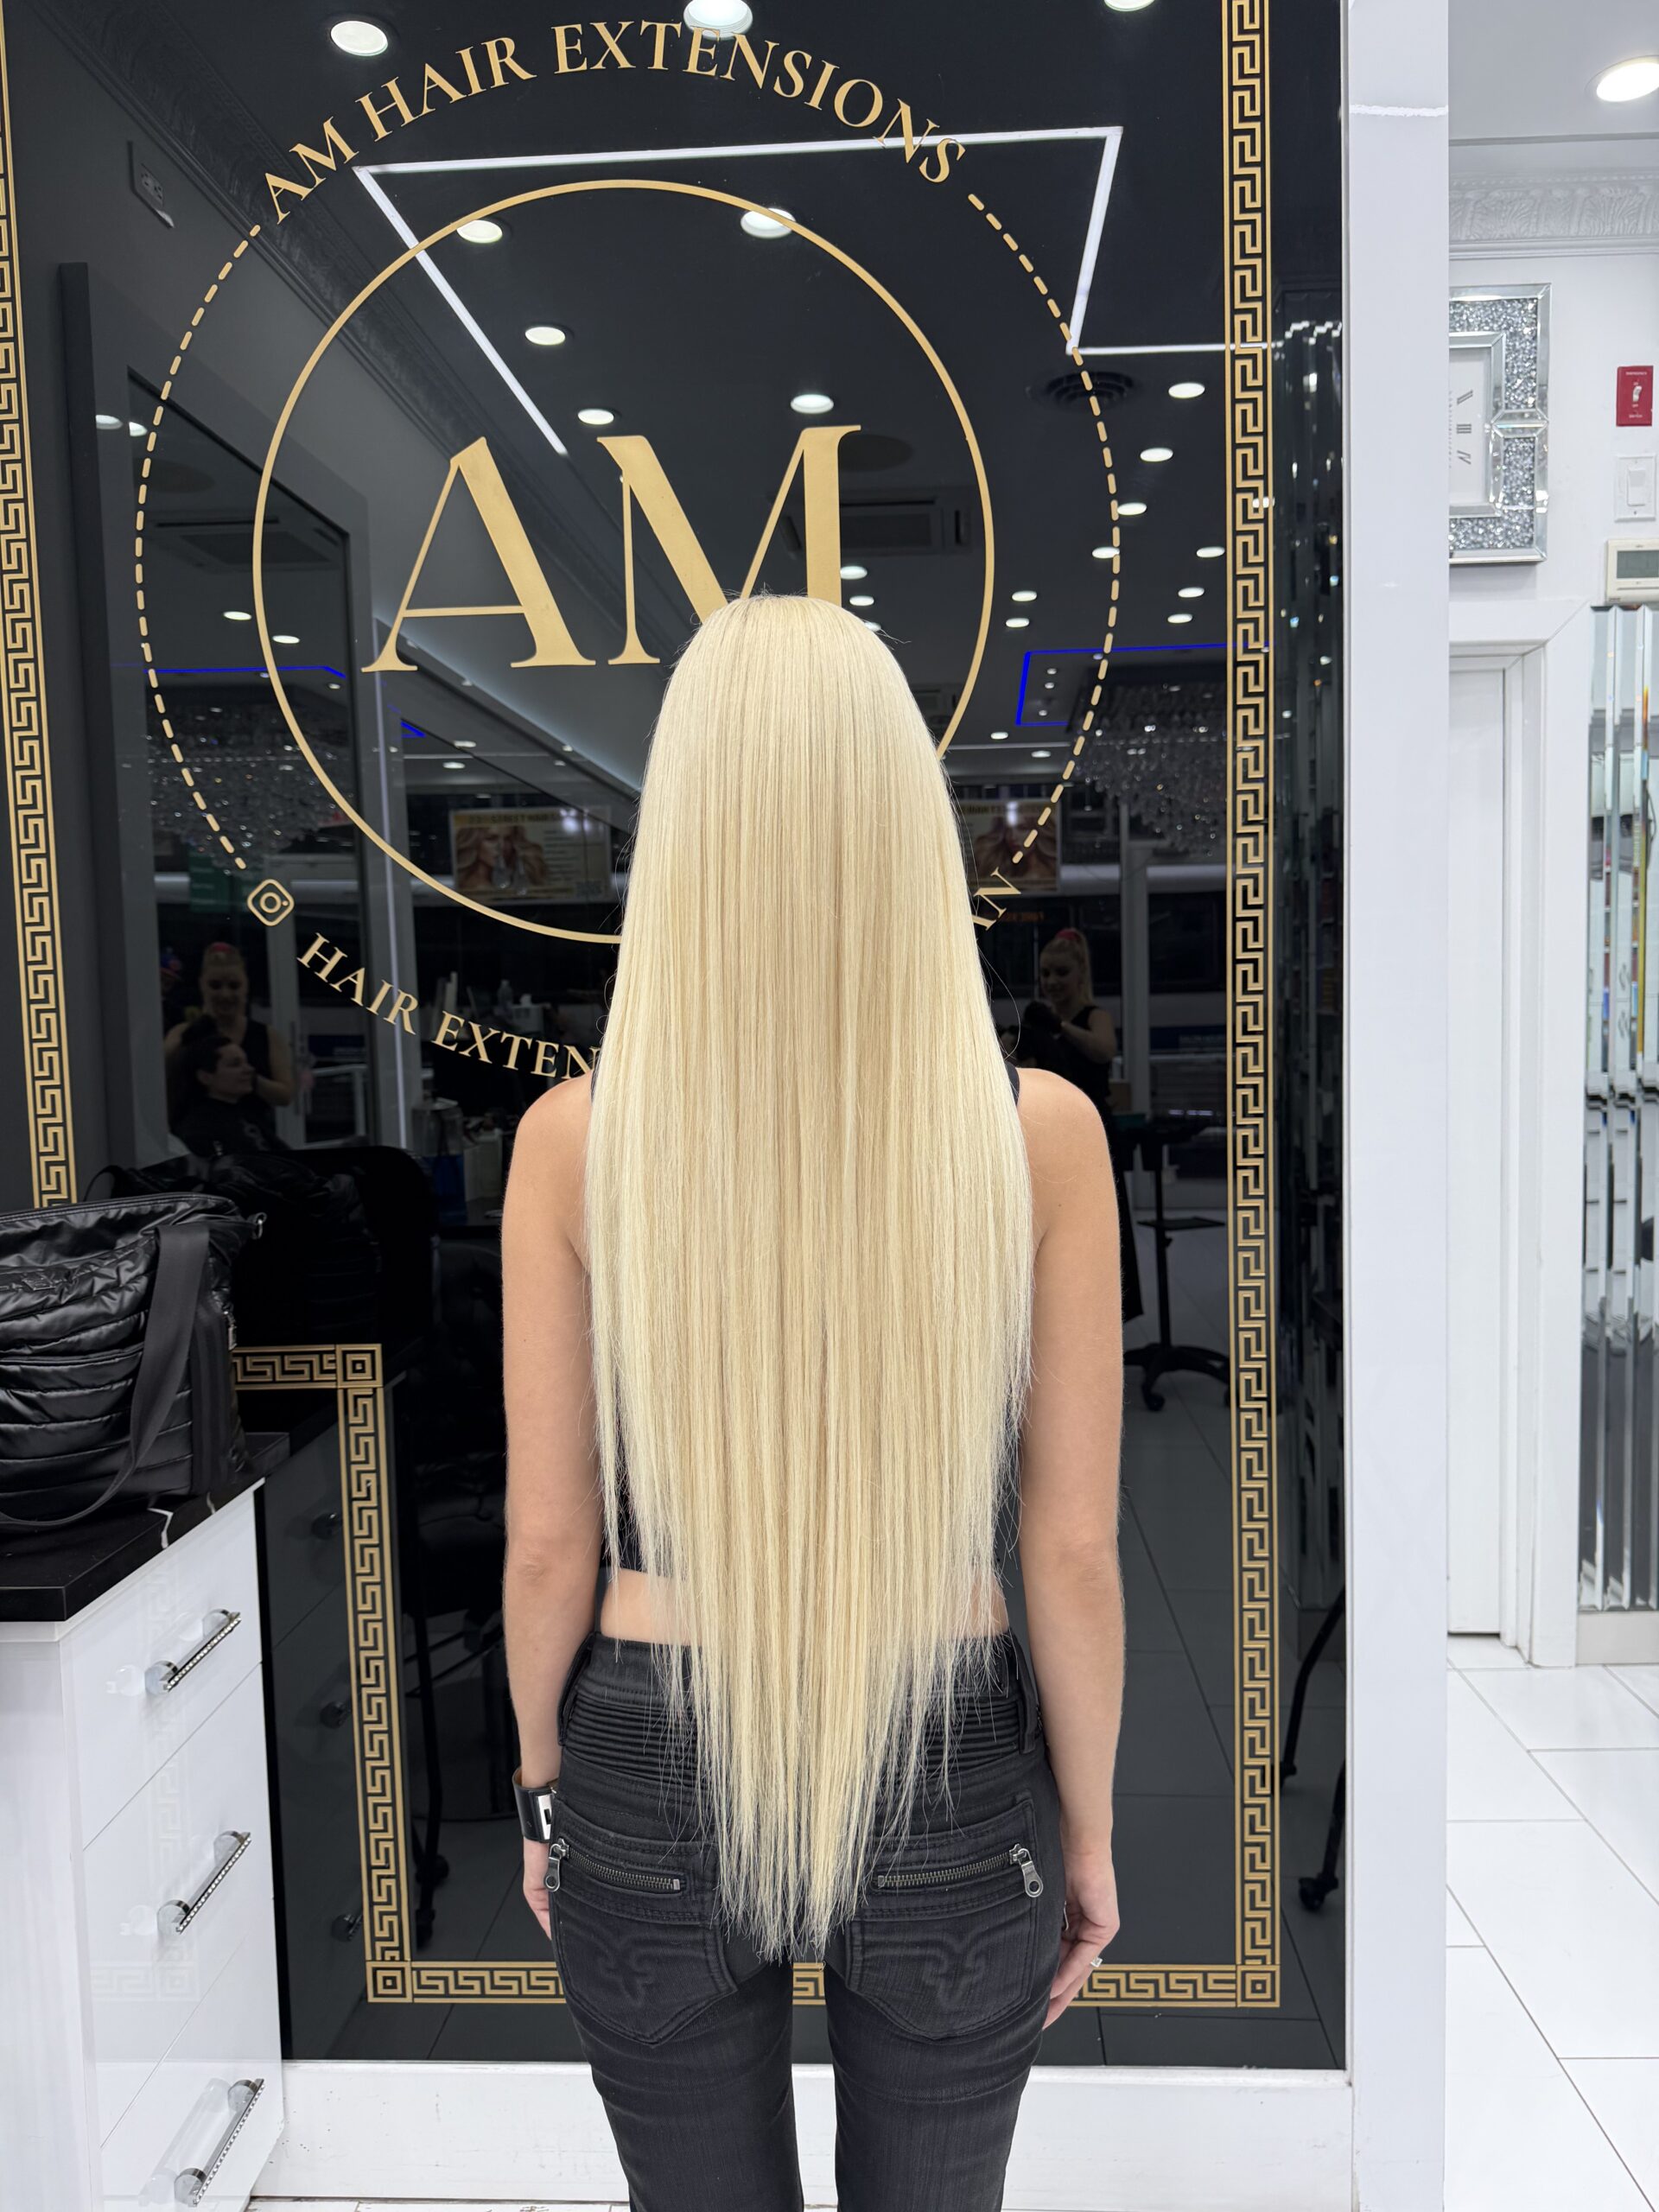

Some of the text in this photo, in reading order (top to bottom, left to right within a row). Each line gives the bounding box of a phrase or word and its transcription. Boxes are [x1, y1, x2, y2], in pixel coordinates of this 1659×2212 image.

[254, 21, 966, 224] AM HAIR EXTENSIONS
[361, 424, 861, 672] AM
[296, 931, 420, 1036] HAIR
